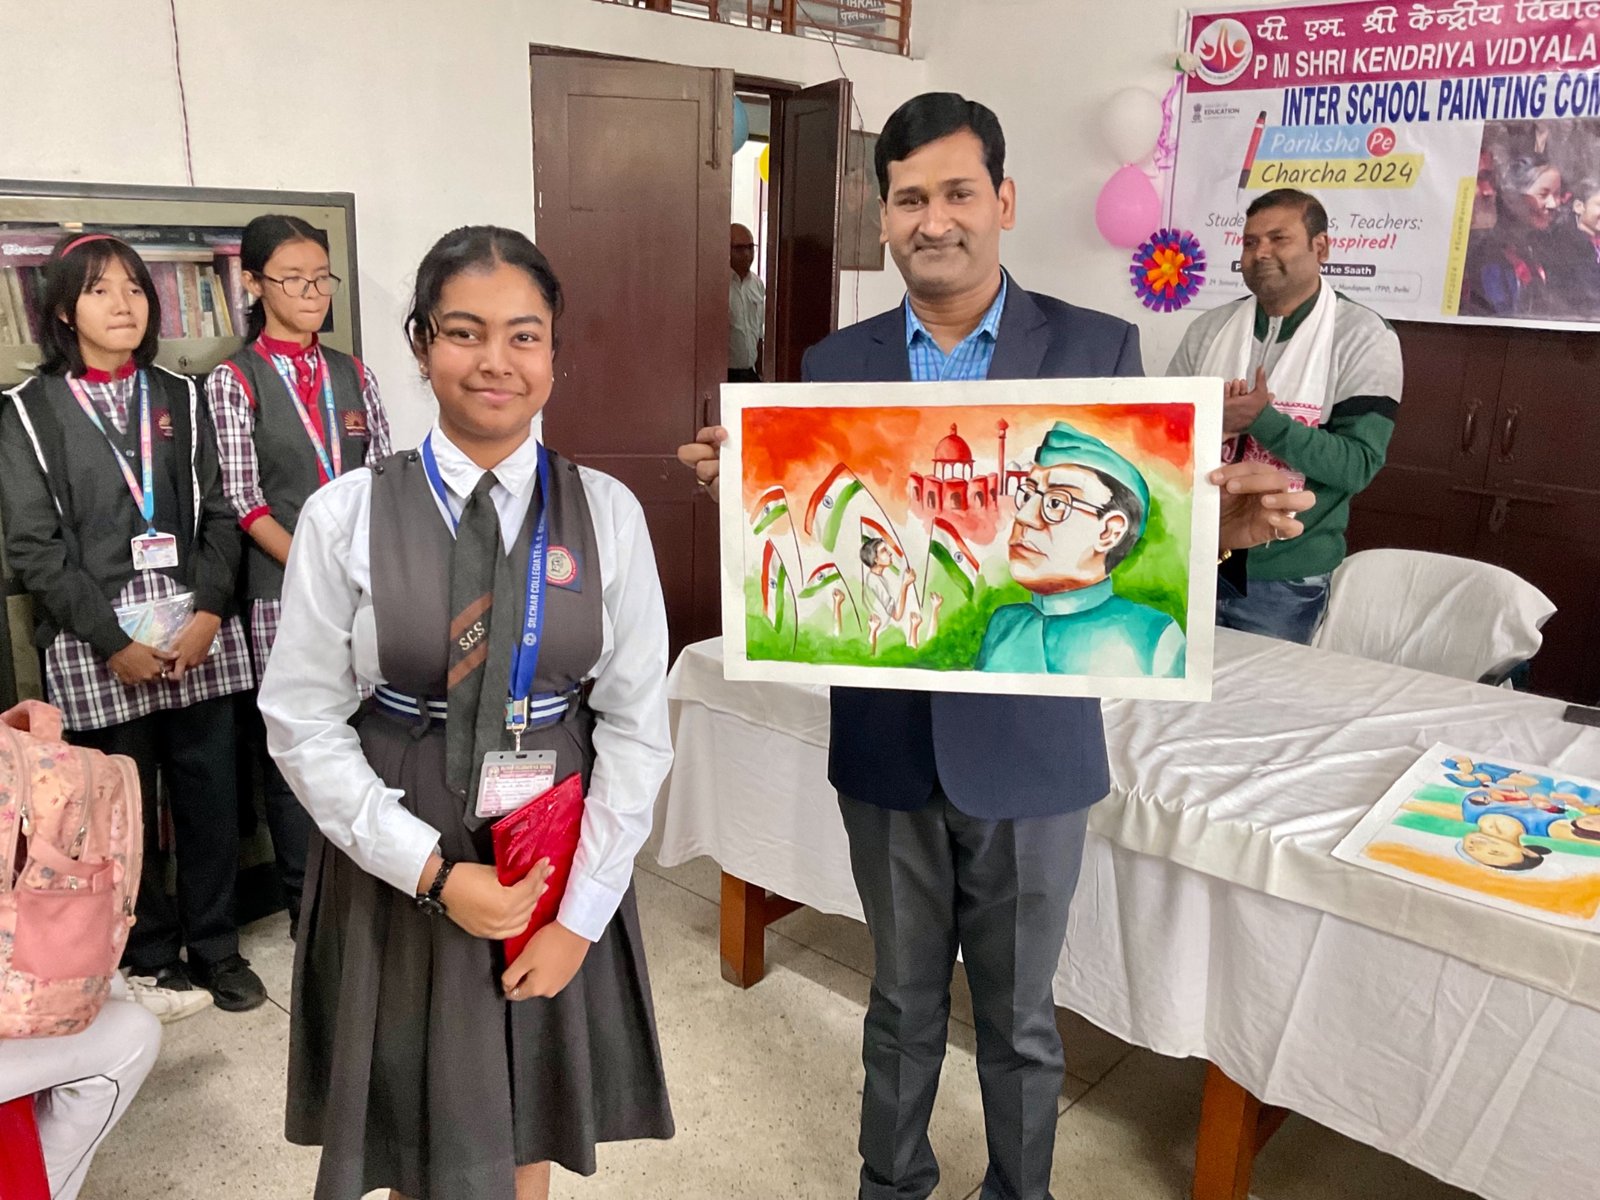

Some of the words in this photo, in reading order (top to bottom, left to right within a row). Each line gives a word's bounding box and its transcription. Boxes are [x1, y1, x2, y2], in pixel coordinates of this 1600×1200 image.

[1304, 18, 1346, 41] एम.
[1362, 6, 1398, 34] श्री
[1408, 0, 1504, 31] केन्द्रीय
[1253, 54, 1268, 79] P
[1273, 52, 1290, 78] M
[1295, 49, 1346, 77] SHRI
[1352, 41, 1476, 74] KENDRIYA
[1486, 33, 1597, 66] VIDYALA
[1281, 86, 1341, 126] INTER
[1345, 81, 1430, 125] SCHOOL
[1437, 74, 1548, 122] PAINTING
[1270, 130, 1360, 153] Pariksha
[1369, 132, 1393, 151] Pe
[1261, 161, 1347, 183] Charcha
[1354, 161, 1413, 183] 2024
[1205, 212, 1244, 227] Stude
[1350, 213, 1423, 231] Teachers:
[1328, 233, 1397, 253] nspired!
[1330, 265, 1342, 274] ke
[1344, 266, 1372, 275] Saath
[530, 550, 543, 594] COLLEGIATE
[527, 594, 540, 629] SILCHAR
